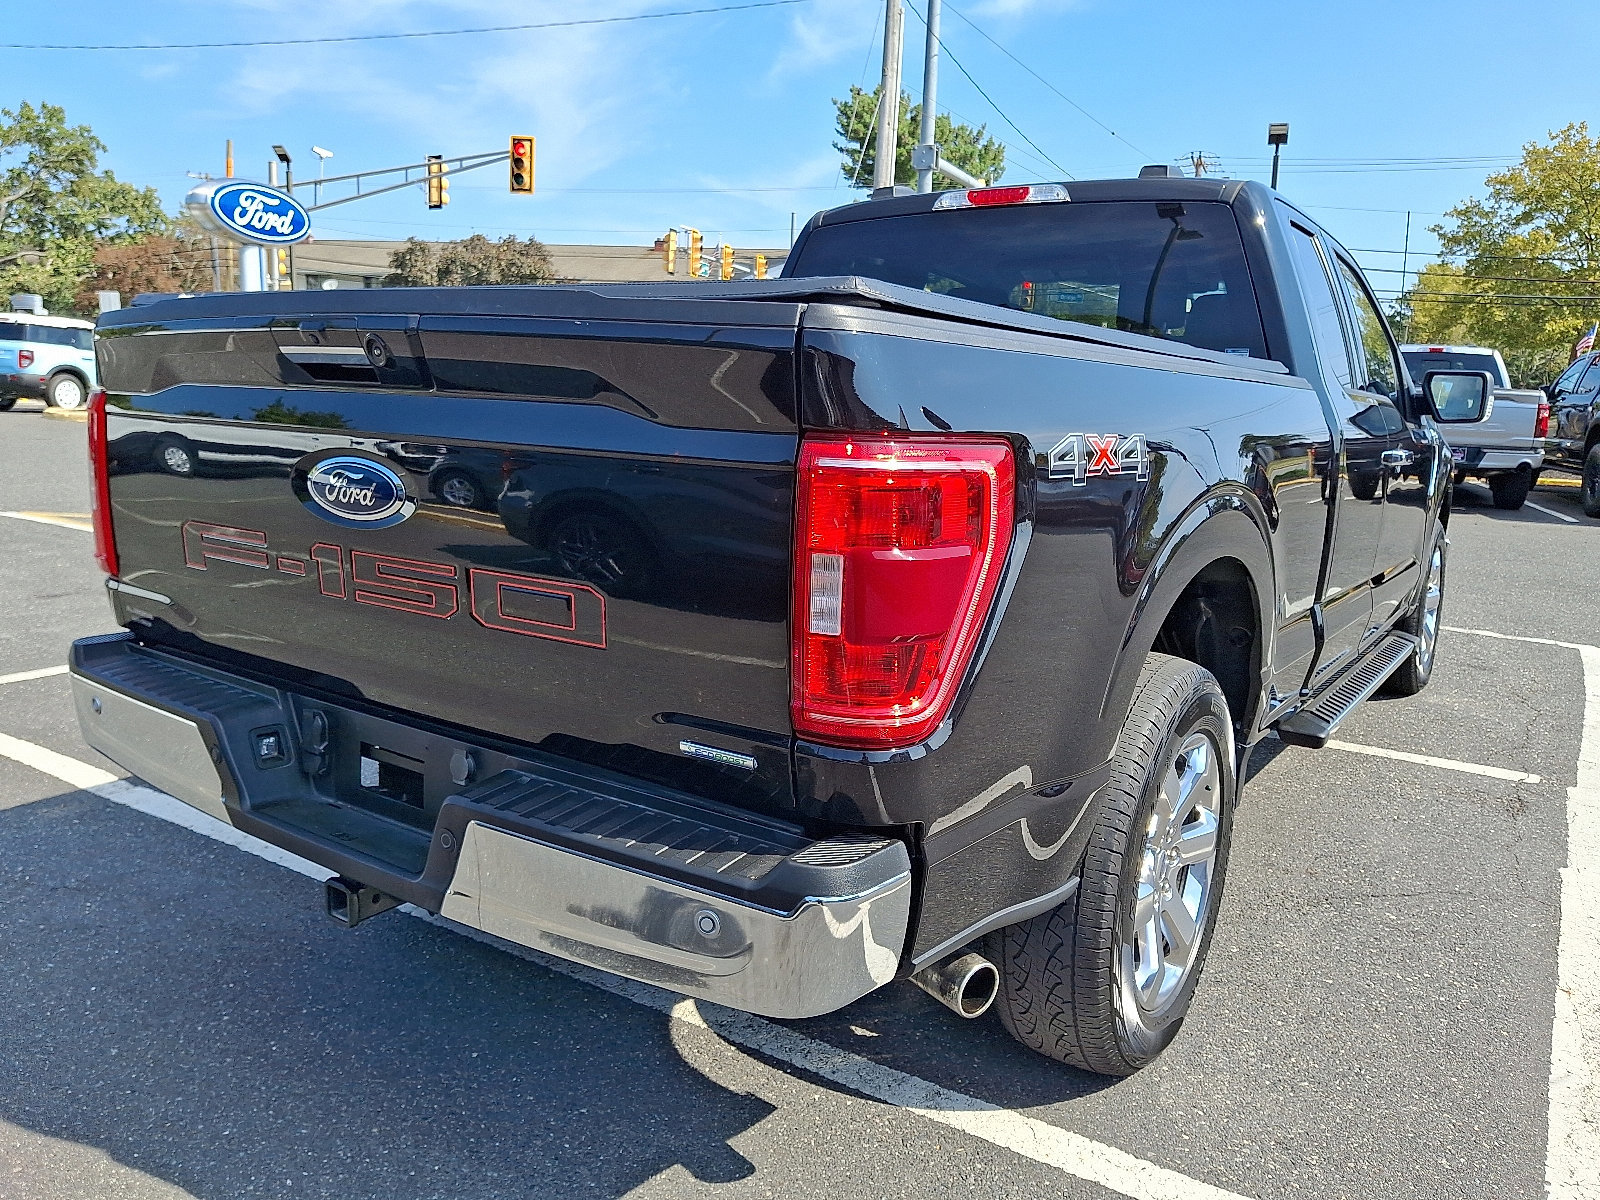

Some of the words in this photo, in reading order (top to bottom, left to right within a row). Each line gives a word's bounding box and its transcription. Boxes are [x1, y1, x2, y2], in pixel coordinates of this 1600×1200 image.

[233, 190, 295, 235] Ford
[325, 469, 377, 507] Ford
[182, 520, 606, 649] F-150
